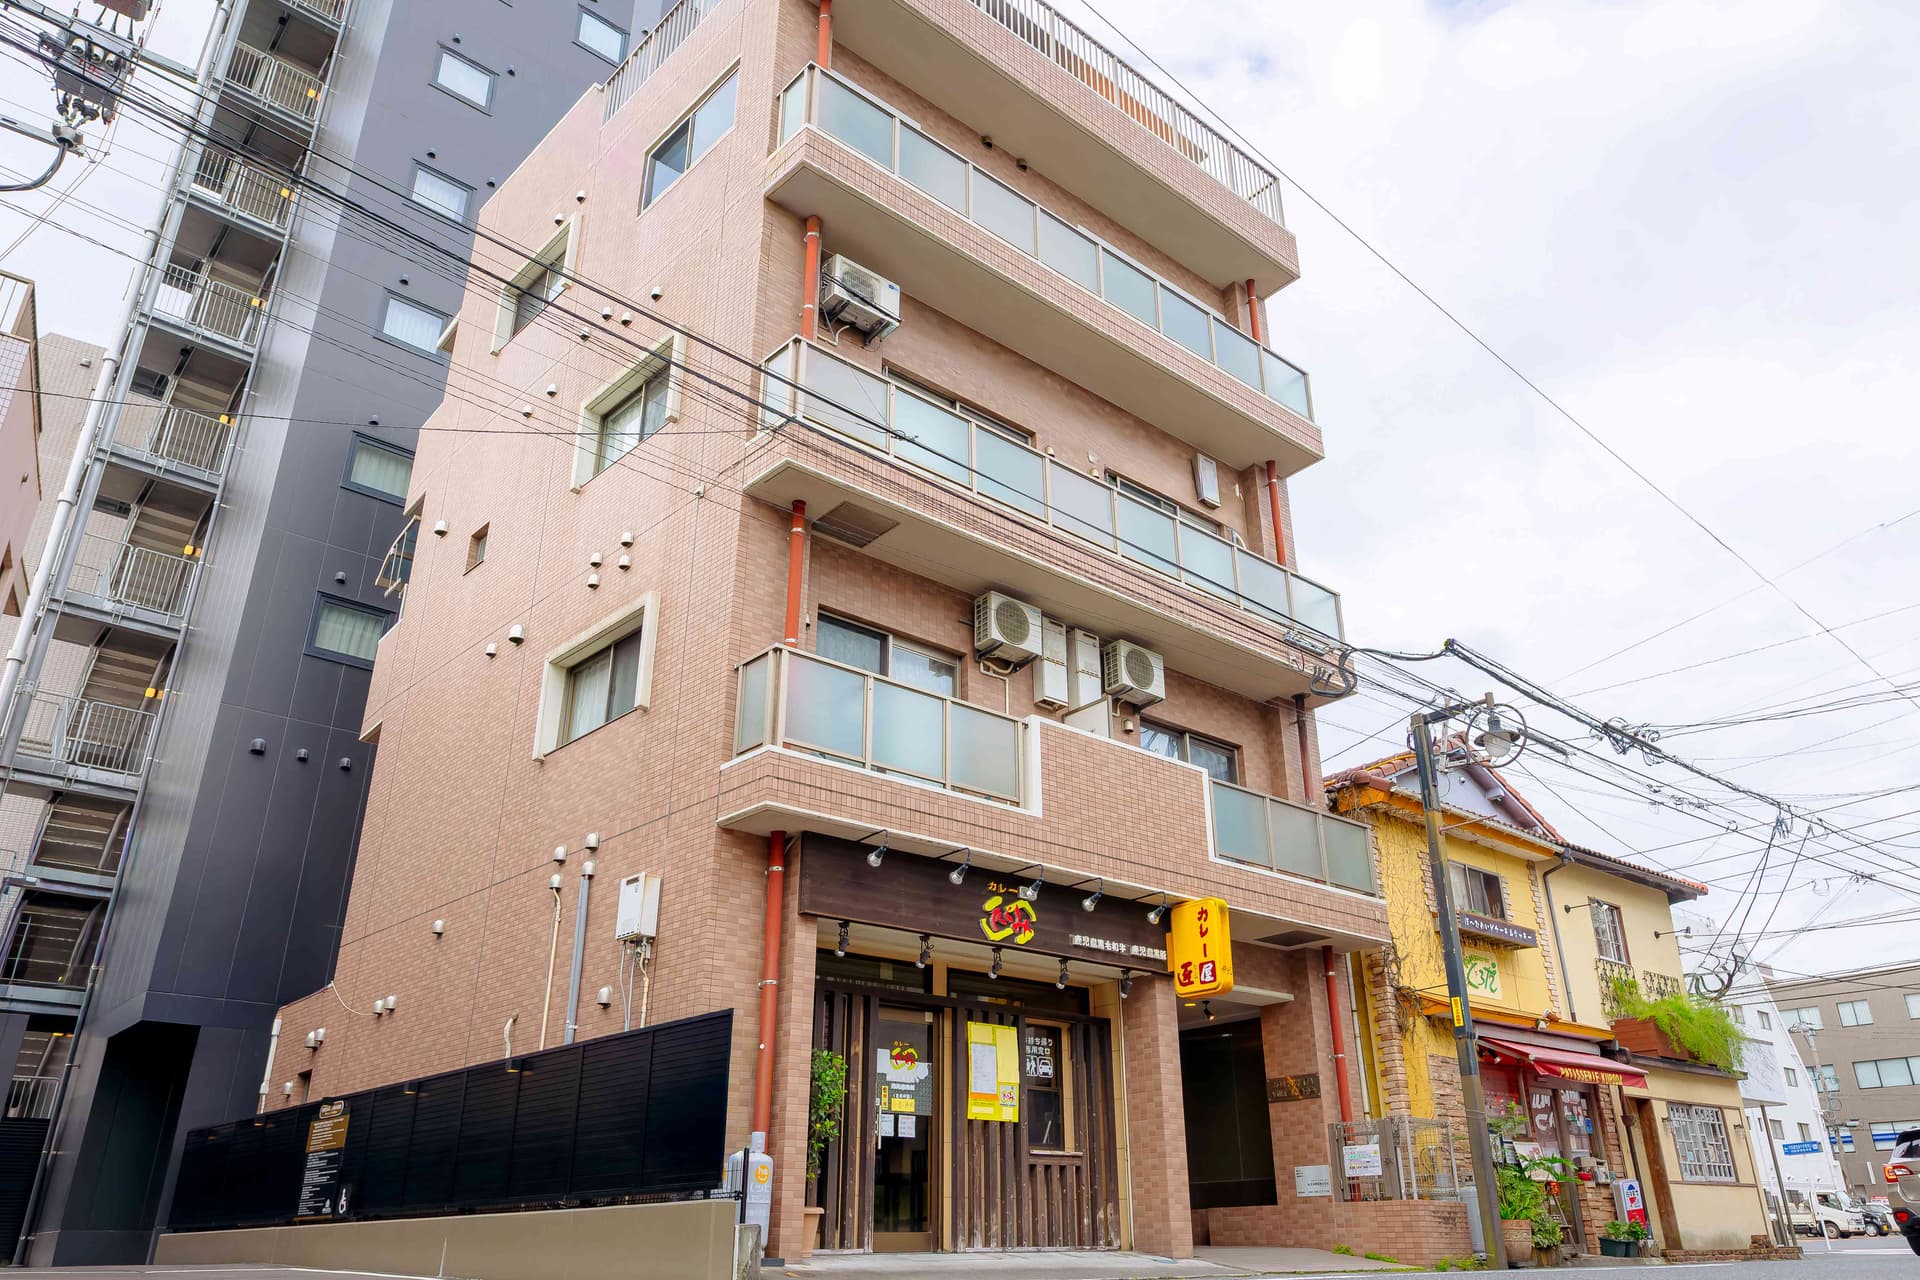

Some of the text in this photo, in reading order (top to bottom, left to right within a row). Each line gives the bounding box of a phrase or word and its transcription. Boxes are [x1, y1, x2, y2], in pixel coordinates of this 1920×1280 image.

[987, 881, 1018, 893] カレー
[1072, 934, 1127, 953] 鹿児島黒毛和牛
[1025, 1036, 1053, 1047] 持ち帰り
[1559, 1067, 1624, 1085] PATISSERIE KURODA
